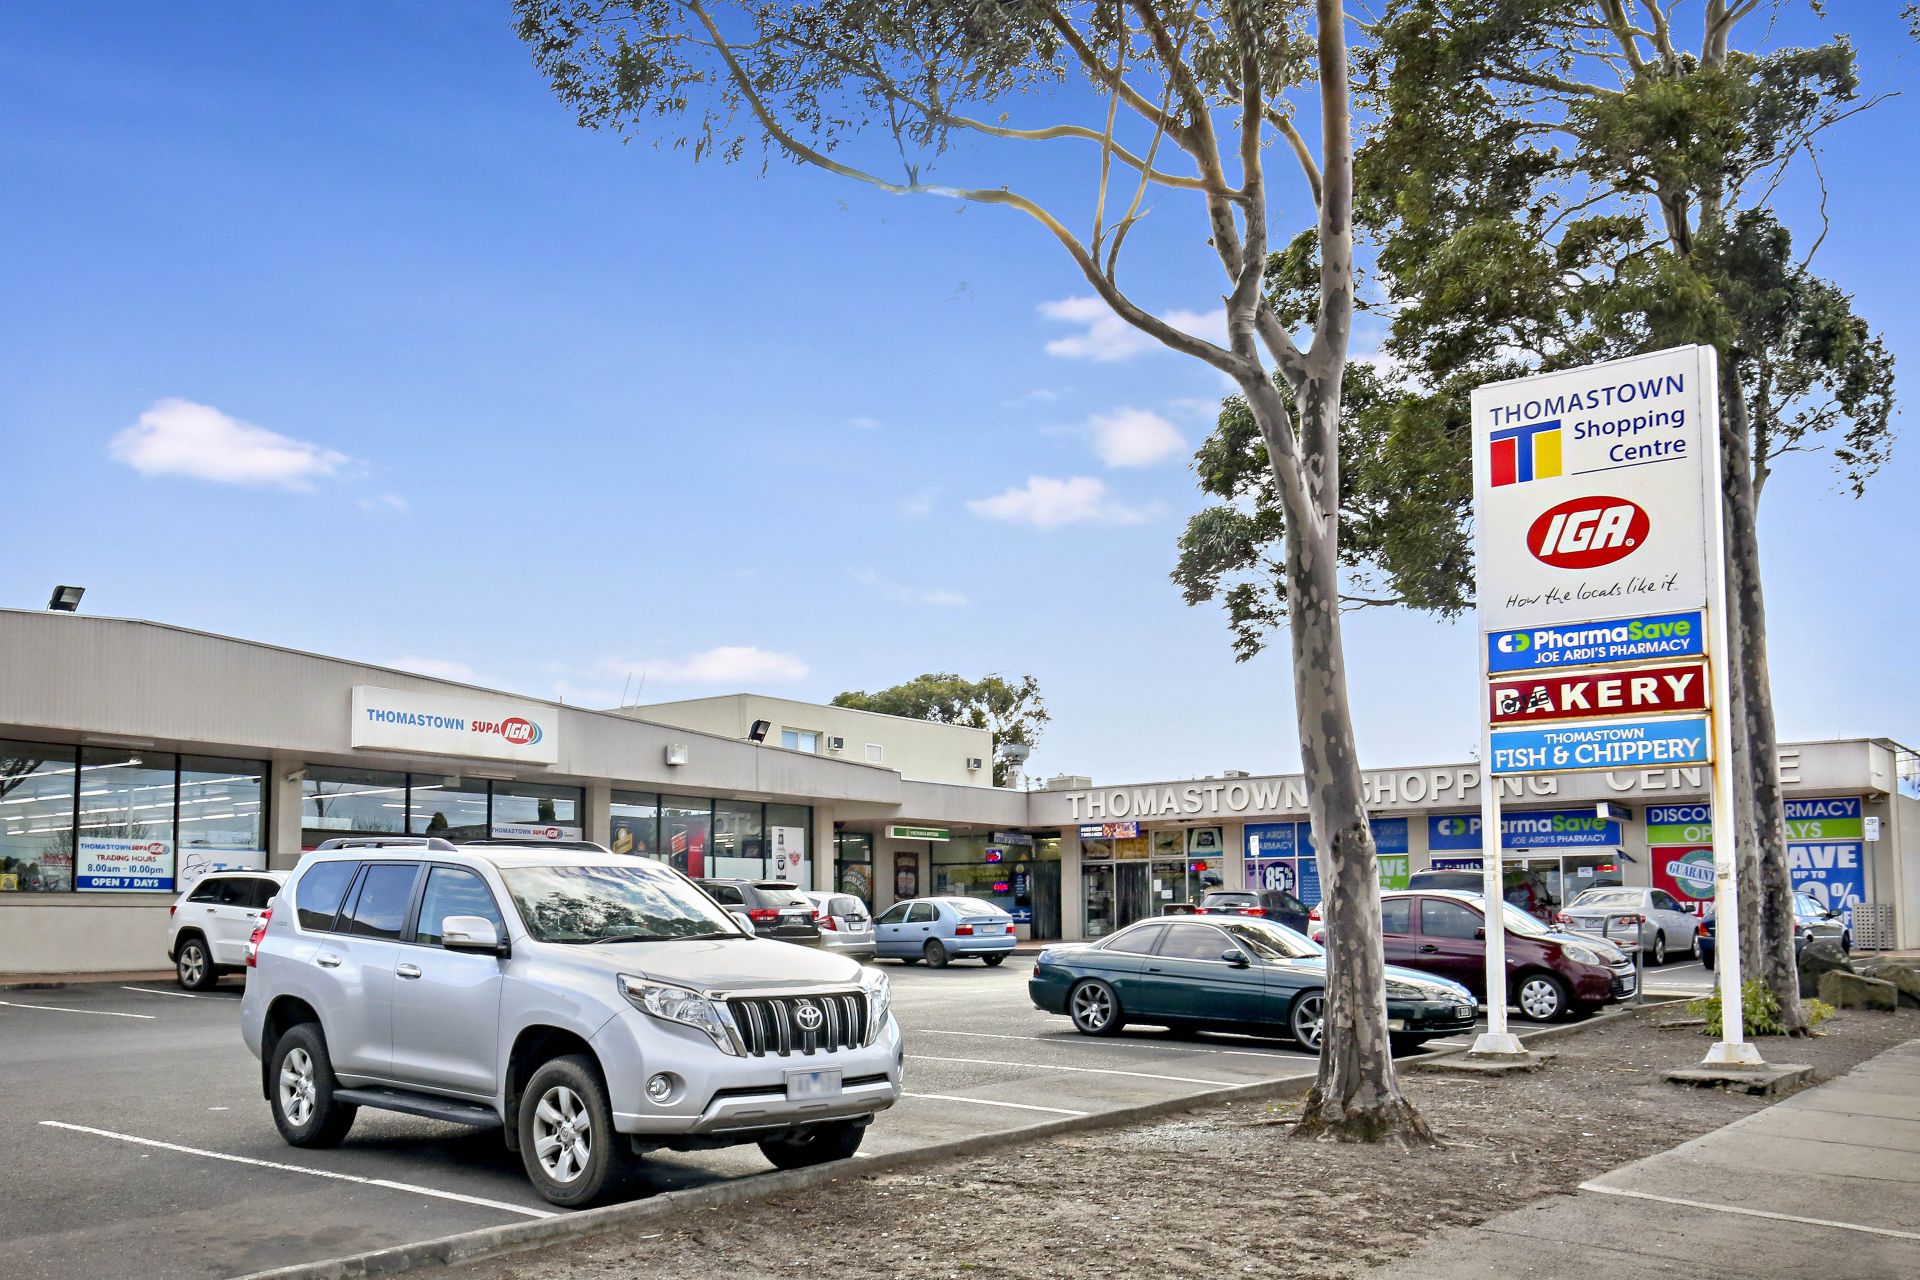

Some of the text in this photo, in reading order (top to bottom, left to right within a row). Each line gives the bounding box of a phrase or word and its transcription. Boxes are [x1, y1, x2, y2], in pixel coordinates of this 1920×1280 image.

[1489, 373, 1684, 426] THOMASTOWN
[1574, 409, 1686, 440] Shopping
[1609, 439, 1687, 463] Centre
[1506, 594, 1541, 608] How
[1545, 587, 1570, 605] the
[1576, 583, 1621, 601] locals
[1626, 577, 1656, 596] like
[1535, 620, 1691, 650] PharmaSave
[1534, 638, 1690, 664] JOE ARDI'S PHARMACY
[367, 708, 532, 740] THOMASTOWN SUPA IGA
[1544, 727, 1645, 745] THOMASTOWN
[1495, 737, 1700, 769] FISH & CHIPPERY
[1066, 751, 1800, 819] THOMASTOWN HOPPNG CENE
[491, 827, 531, 835] THOMASTOWN
[1469, 814, 1607, 835] ParmaSave
[80, 843, 130, 851] THOMASTOWN
[1248, 842, 1293, 850] ARMACY
[1511, 836, 1526, 844] JOE
[1557, 834, 1606, 842] PHARMACY
[87, 863, 120, 872] 8.00am
[129, 865, 163, 875] 10.00pm
[96, 854, 156, 863] TRADING HOURS
[91, 878, 159, 887] OPEN 7 DAYS
[1793, 870, 1826, 879] UP TO
